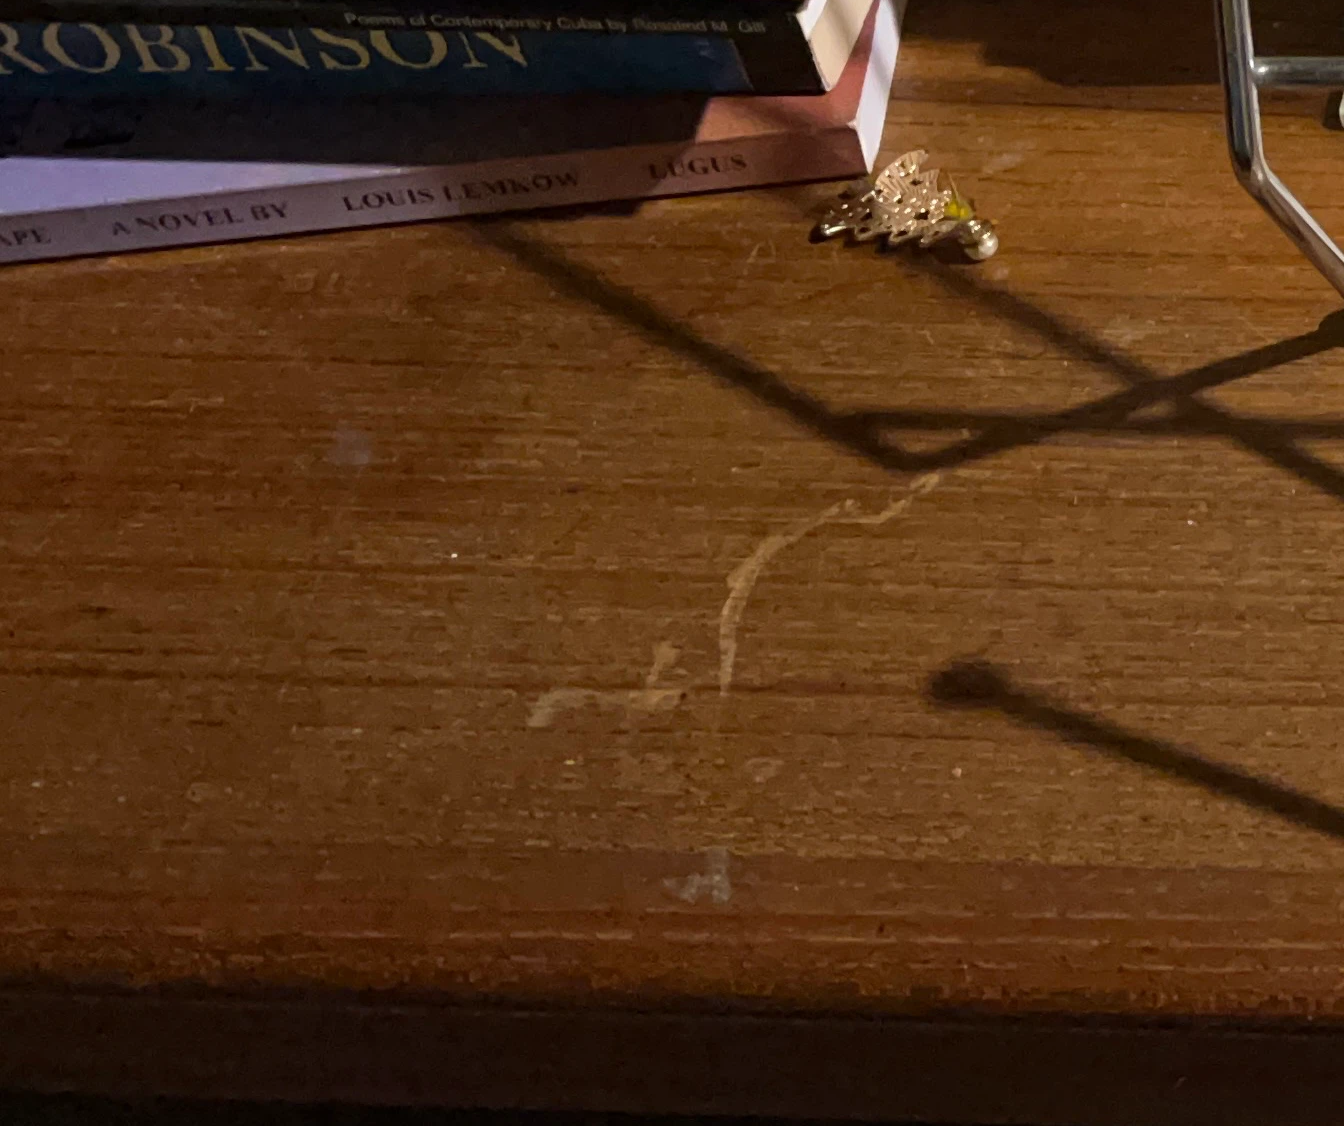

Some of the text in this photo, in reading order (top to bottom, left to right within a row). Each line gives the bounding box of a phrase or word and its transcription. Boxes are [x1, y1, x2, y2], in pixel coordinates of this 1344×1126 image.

[649, 153, 748, 180] LUGUS
[342, 172, 579, 213] LOUIS LEMKOW
[111, 201, 290, 237] A NOVEL BY
